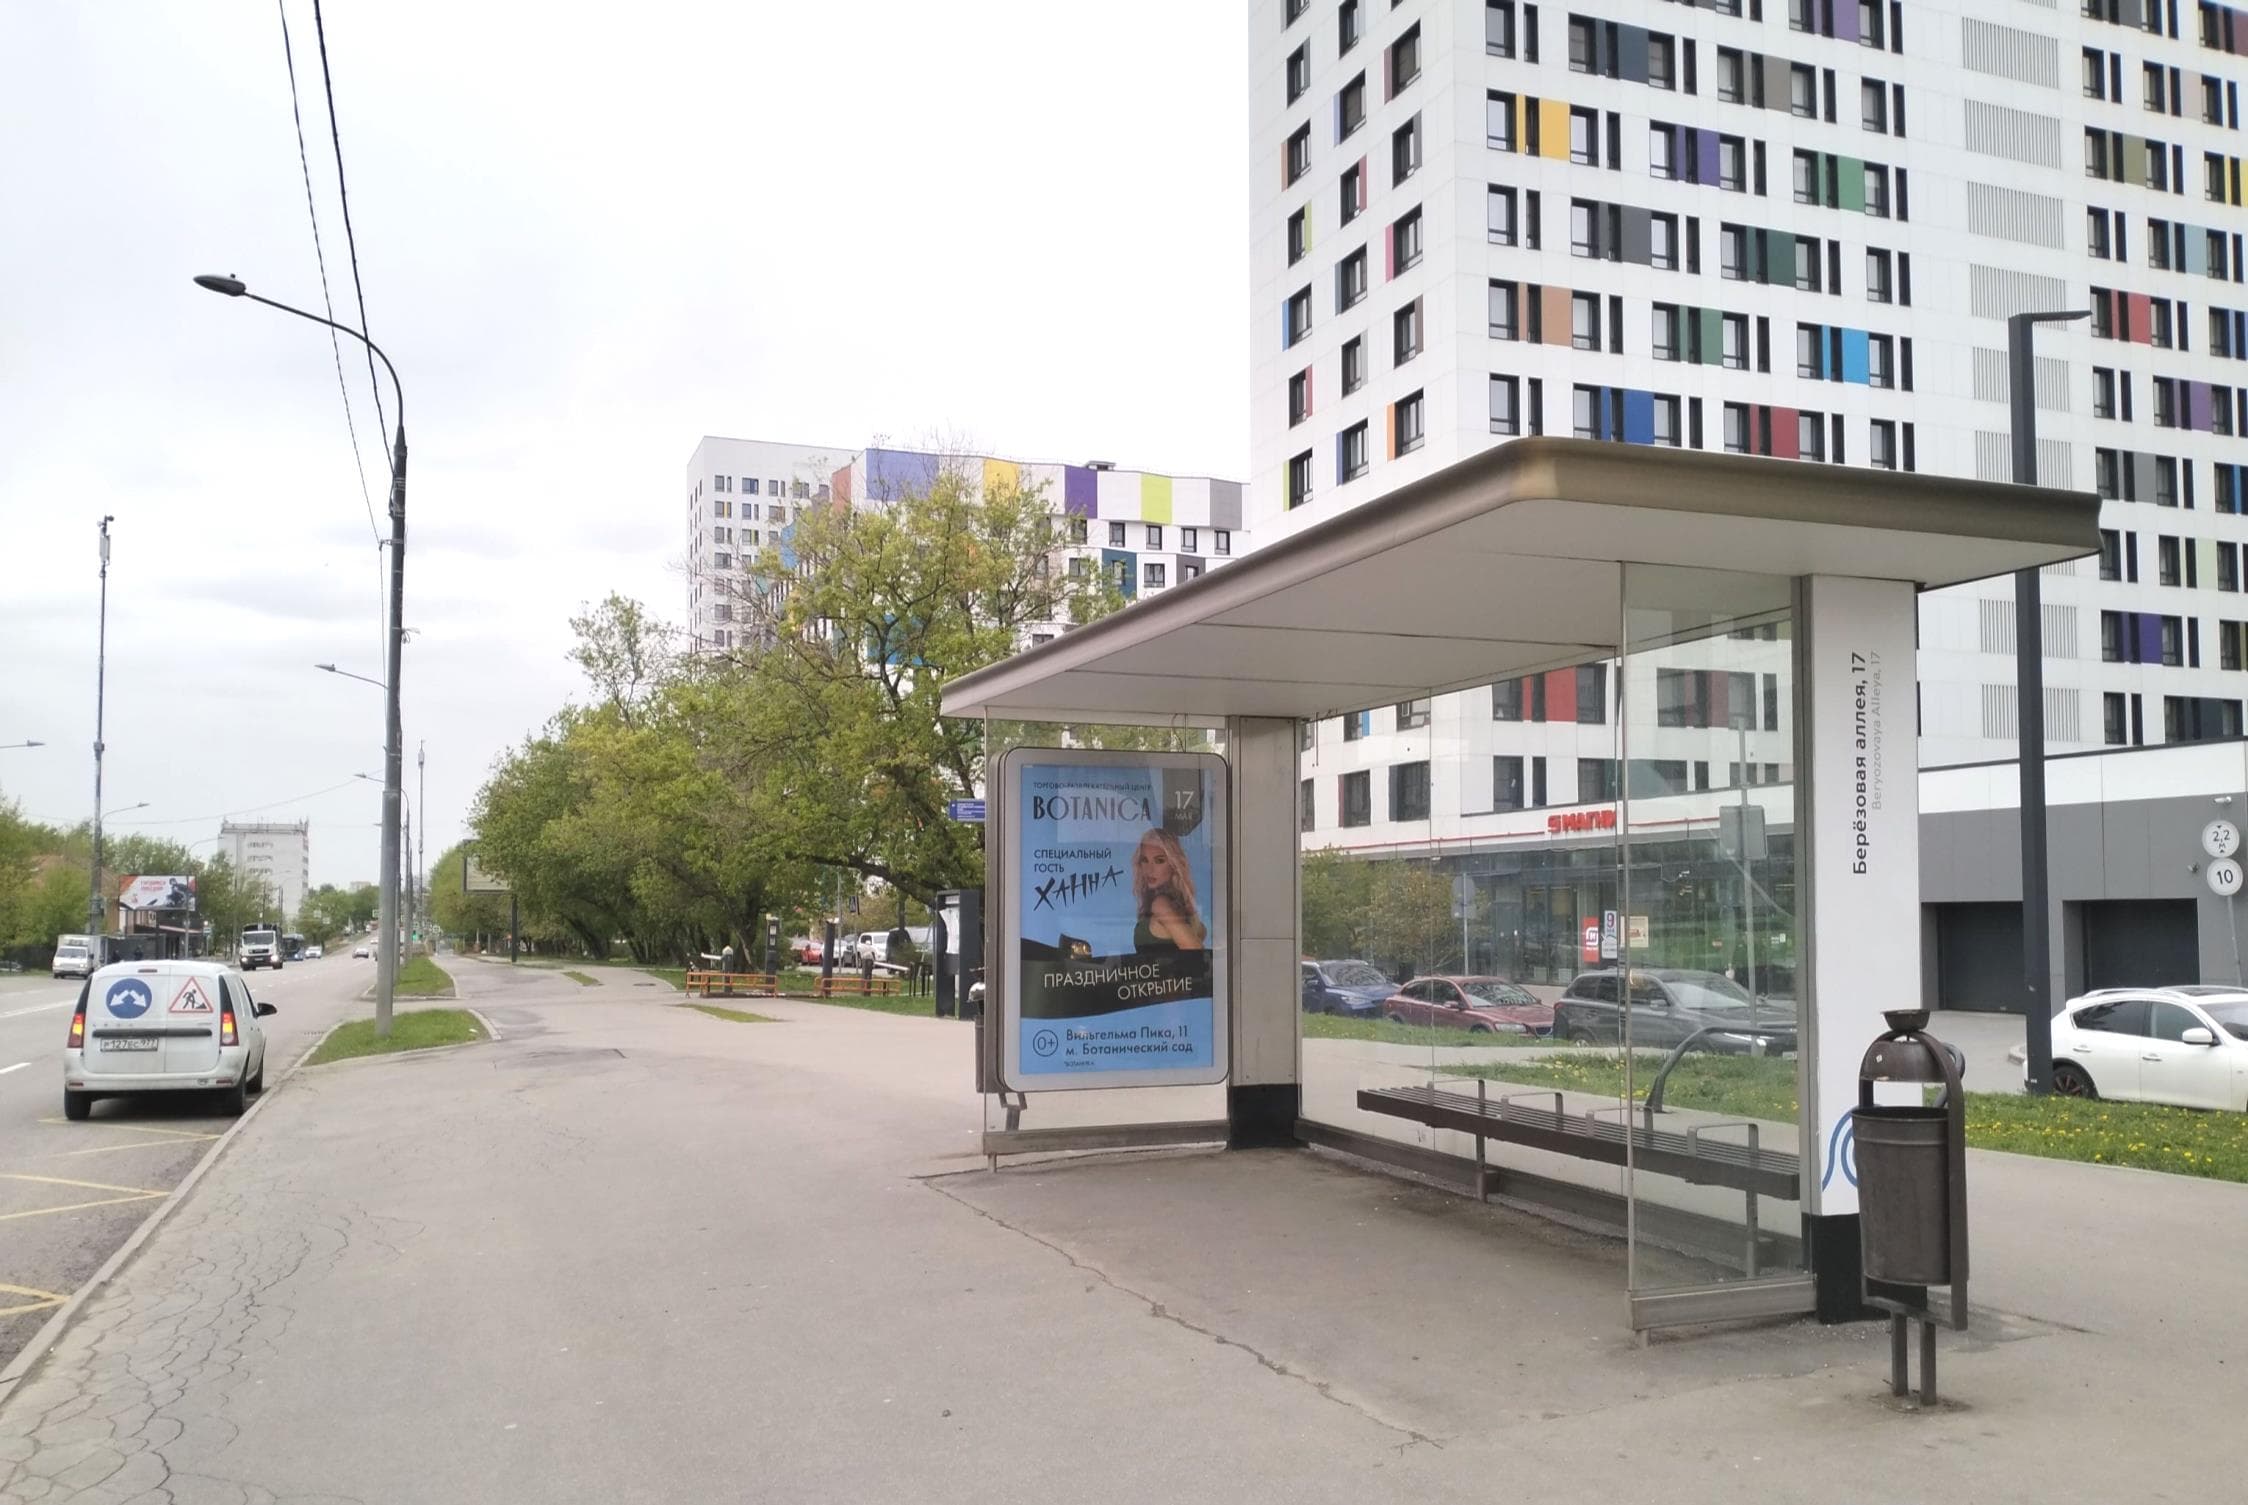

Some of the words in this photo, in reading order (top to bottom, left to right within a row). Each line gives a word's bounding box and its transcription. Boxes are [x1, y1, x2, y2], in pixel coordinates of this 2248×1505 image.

[1851, 651, 1866, 674] 17
[1870, 651, 1881, 665] 17
[1871, 670, 1882, 717] Alleya,
[1855, 680, 1869, 750] аллея,
[1871, 719, 1884, 811] Beryozovaya
[1032, 795, 1152, 822] BOTANICA
[1174, 790, 1195, 810] 17
[1853, 756, 1870, 874] Берёзовая
[2213, 829, 2231, 843] 2,2
[1033, 848, 1112, 860] СПЕЦИАЛЬНЫЙ
[1033, 863, 1065, 873] ГОСТЬ
[2217, 869, 2233, 885] 10
[1033, 864, 1124, 912] ХАННА
[1044, 963, 1160, 988] ПРАЗДНИЧНОЕ
[1117, 976, 1193, 1000] ОТКРЫТИЕ
[1037, 1036, 1055, 1051] 0+
[1066, 1028, 1137, 1042] Вильгельма
[1140, 1026, 1175, 1041] Пика,
[1178, 1025, 1188, 1037] 11
[1065, 1047, 1078, 1056] м.
[1082, 1041, 1169, 1056] Ботанический
[1172, 1042, 1193, 1053] сад
